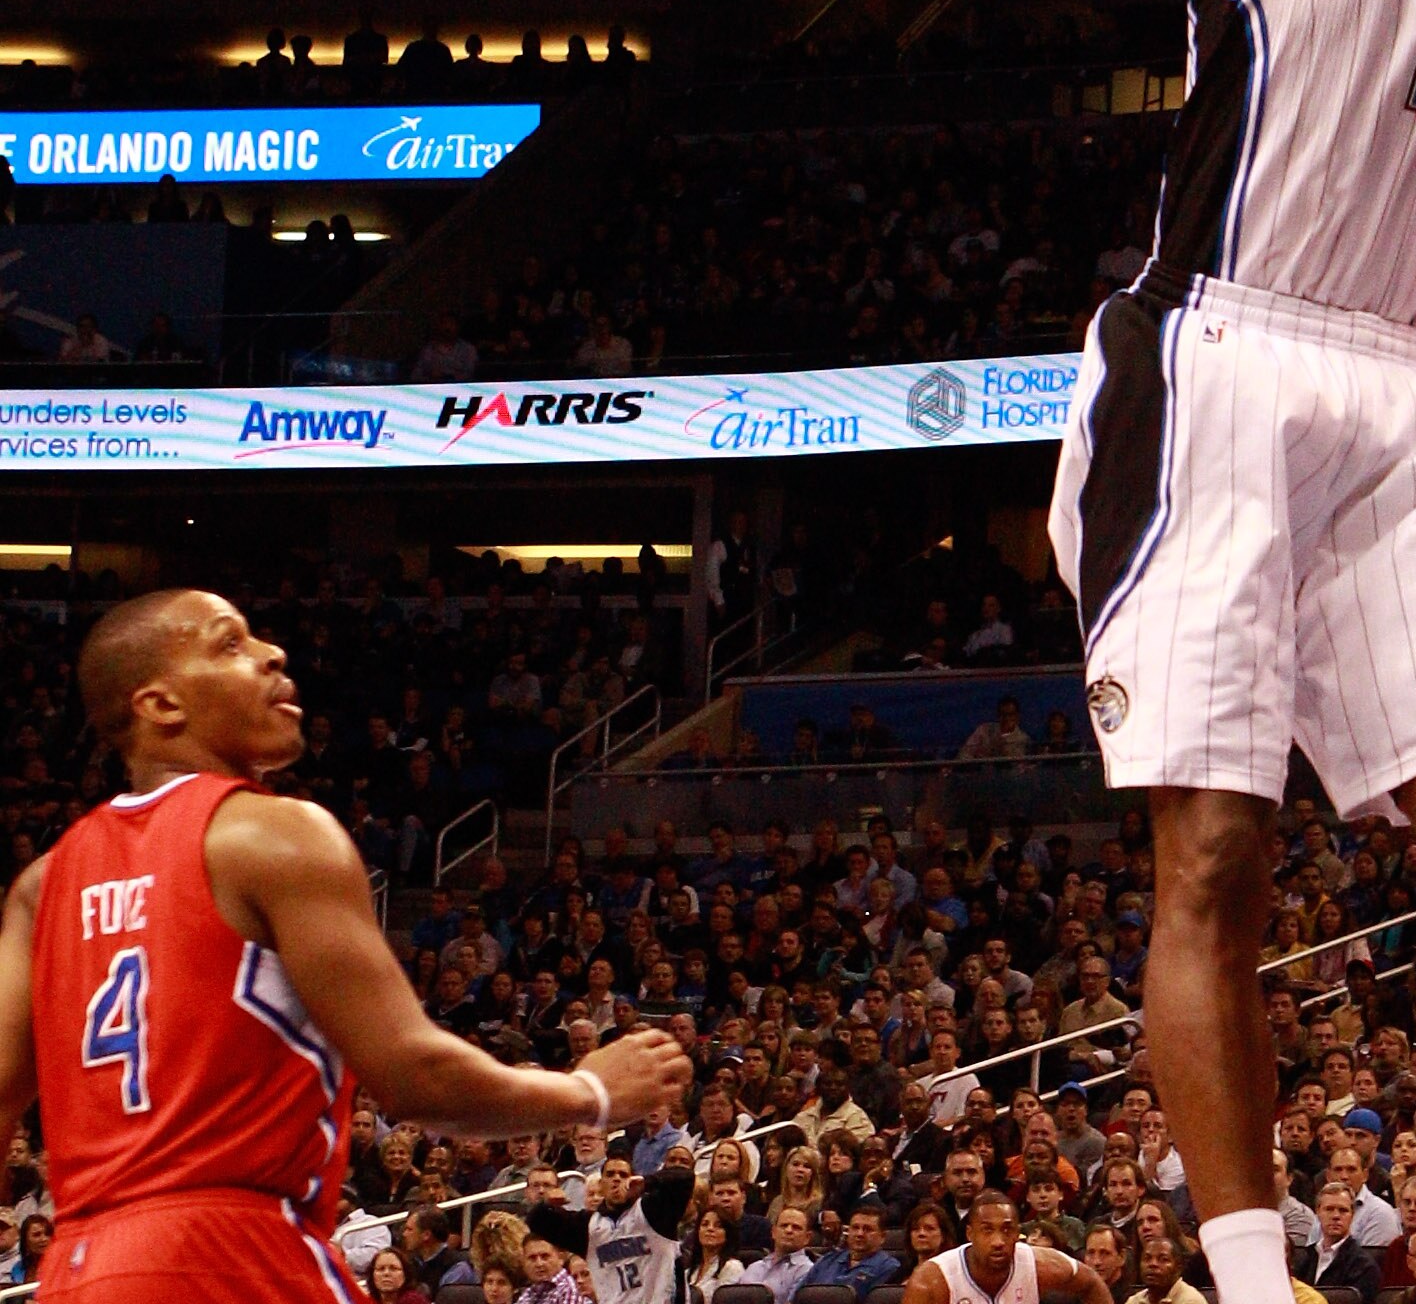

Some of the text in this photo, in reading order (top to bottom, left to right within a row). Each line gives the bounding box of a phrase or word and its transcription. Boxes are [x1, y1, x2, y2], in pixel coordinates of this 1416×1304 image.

[28, 131, 193, 174] ORLANDO
[204, 129, 320, 172] MAGIC
[386, 134, 516, 171] airTra
[102, 398, 188, 424] Levels
[436, 390, 646, 450] HARRIS
[710, 407, 860, 451] airTran
[82, 945, 152, 1116] 4
[616, 1262, 643, 1293] 12
